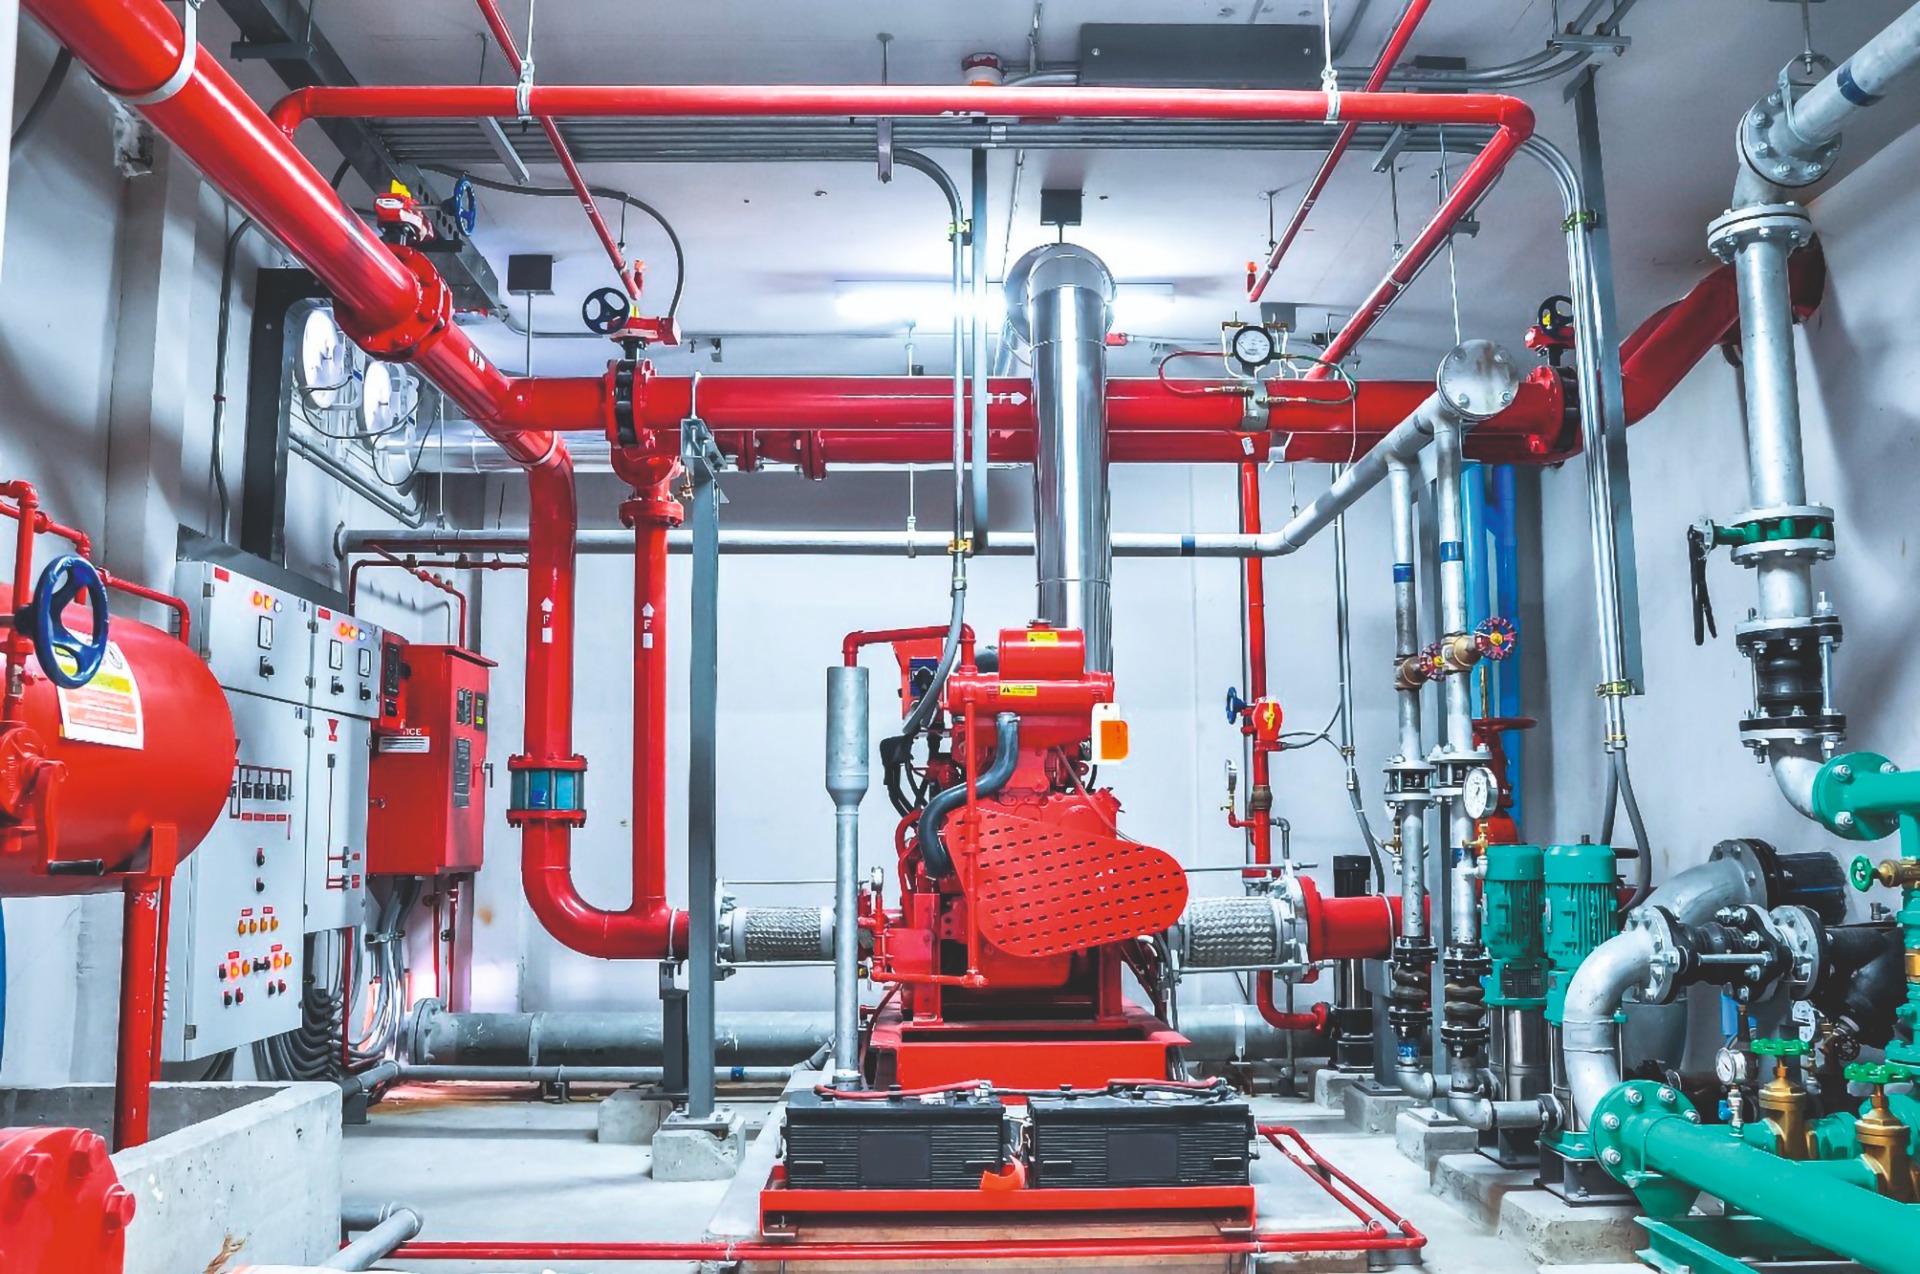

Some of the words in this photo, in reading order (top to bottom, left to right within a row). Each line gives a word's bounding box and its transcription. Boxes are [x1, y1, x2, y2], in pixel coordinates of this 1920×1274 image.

[998, 392, 1007, 404] F
[543, 614, 551, 624] F
[643, 619, 652, 630] F
